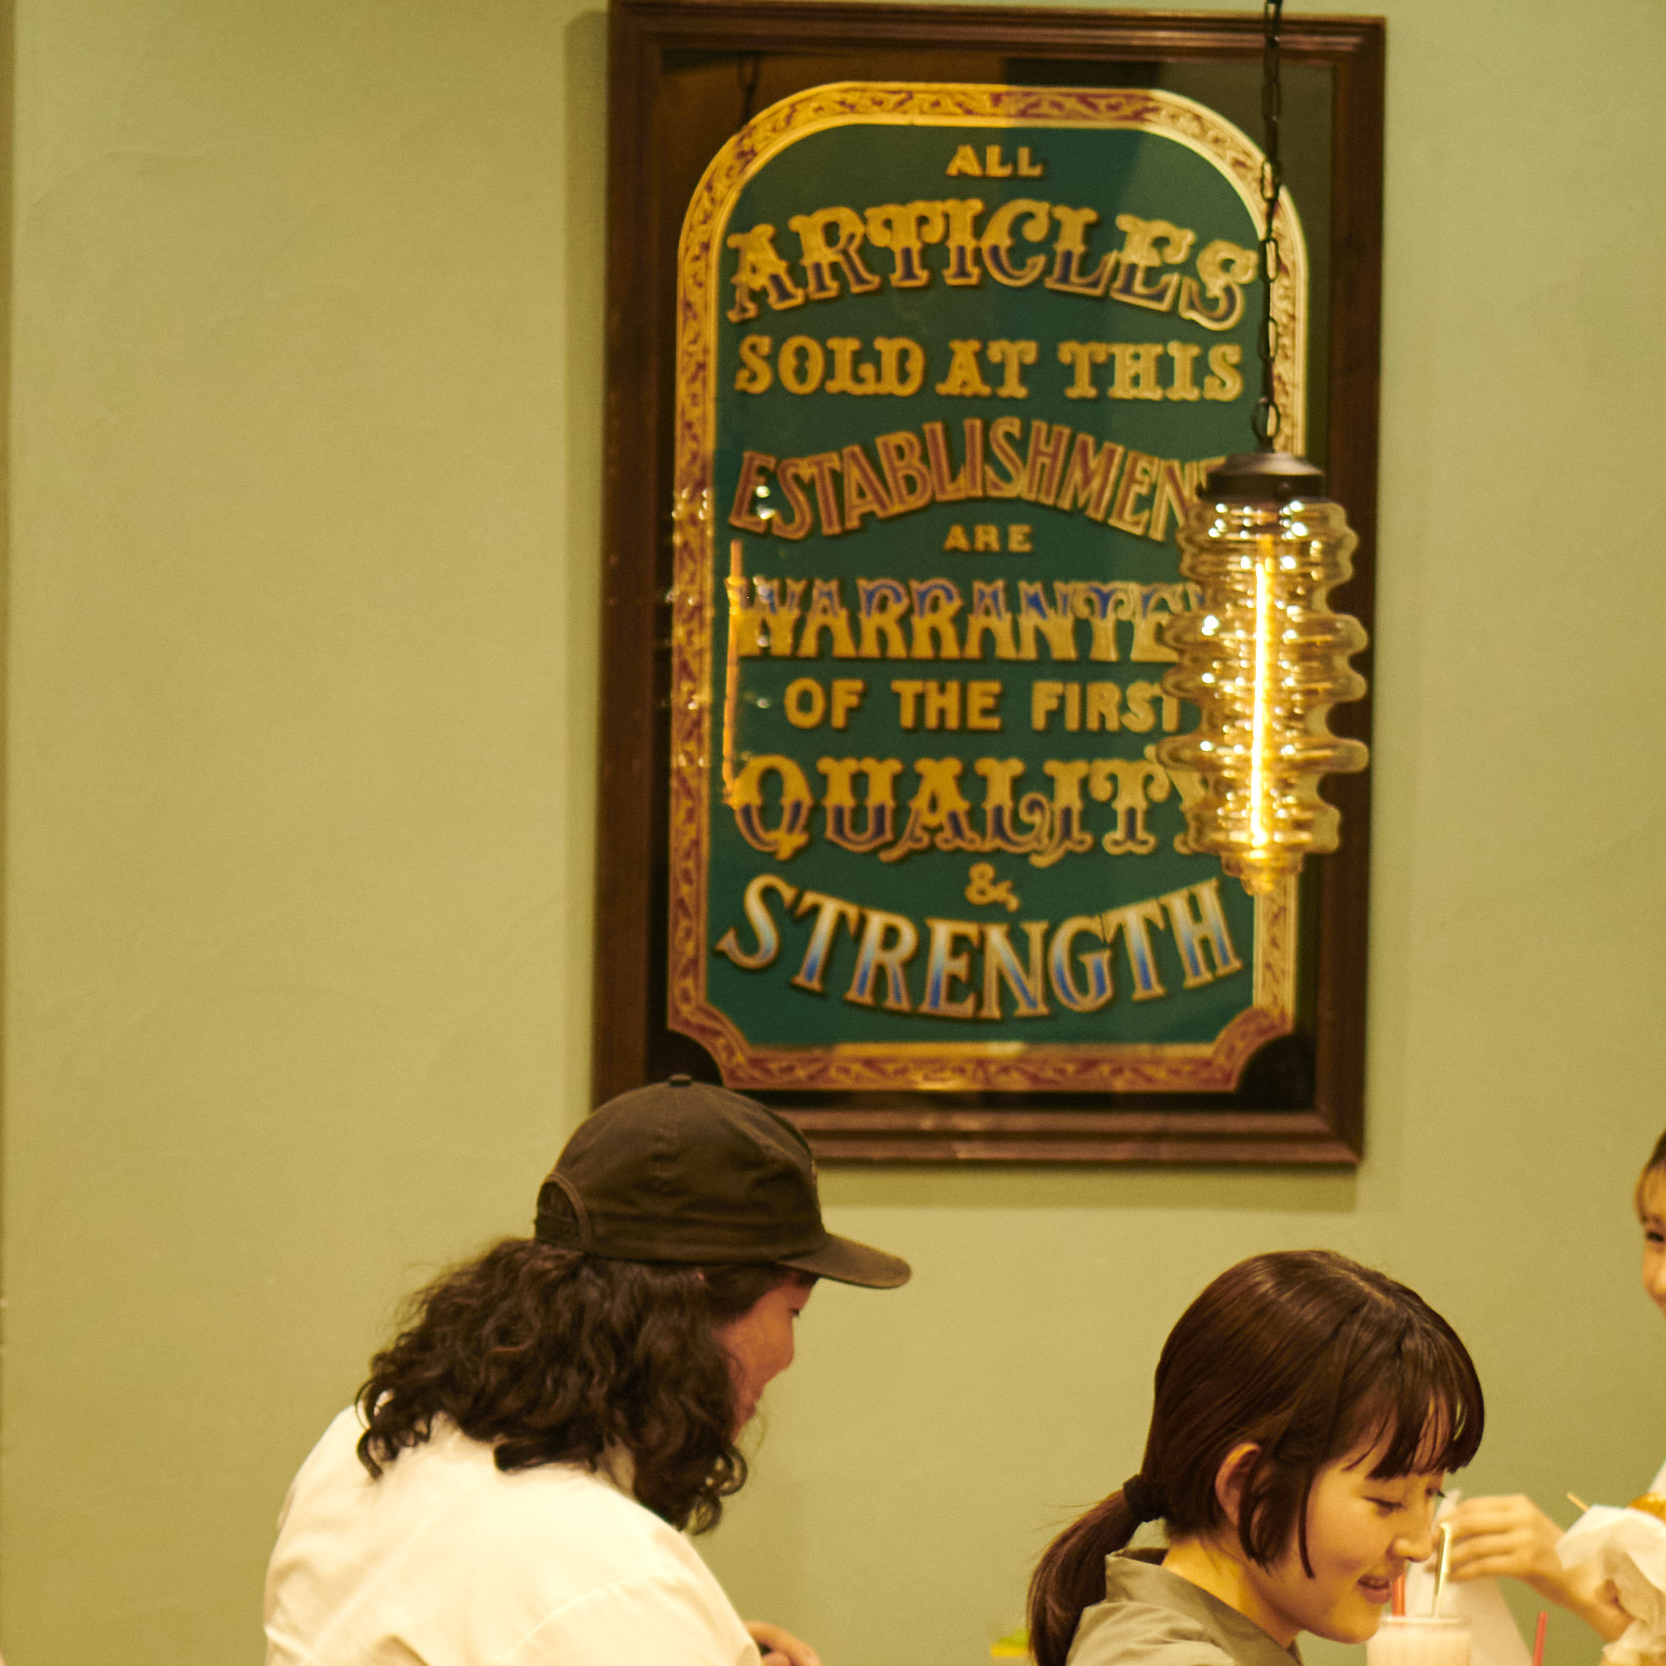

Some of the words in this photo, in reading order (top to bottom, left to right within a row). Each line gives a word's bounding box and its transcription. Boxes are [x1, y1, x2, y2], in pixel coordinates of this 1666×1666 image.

[946, 144, 1044, 178] ALL
[727, 199, 1259, 331] ARTICLES
[735, 335, 926, 398] SOLD
[935, 339, 1039, 398] AT
[1058, 340, 1244, 402] THIS
[942, 525, 1034, 553] ARE
[784, 679, 865, 730] OF
[892, 680, 1002, 731] THE
[1032, 681, 1183, 733] FIRST
[714, 874, 1243, 1021] STRENGTH
